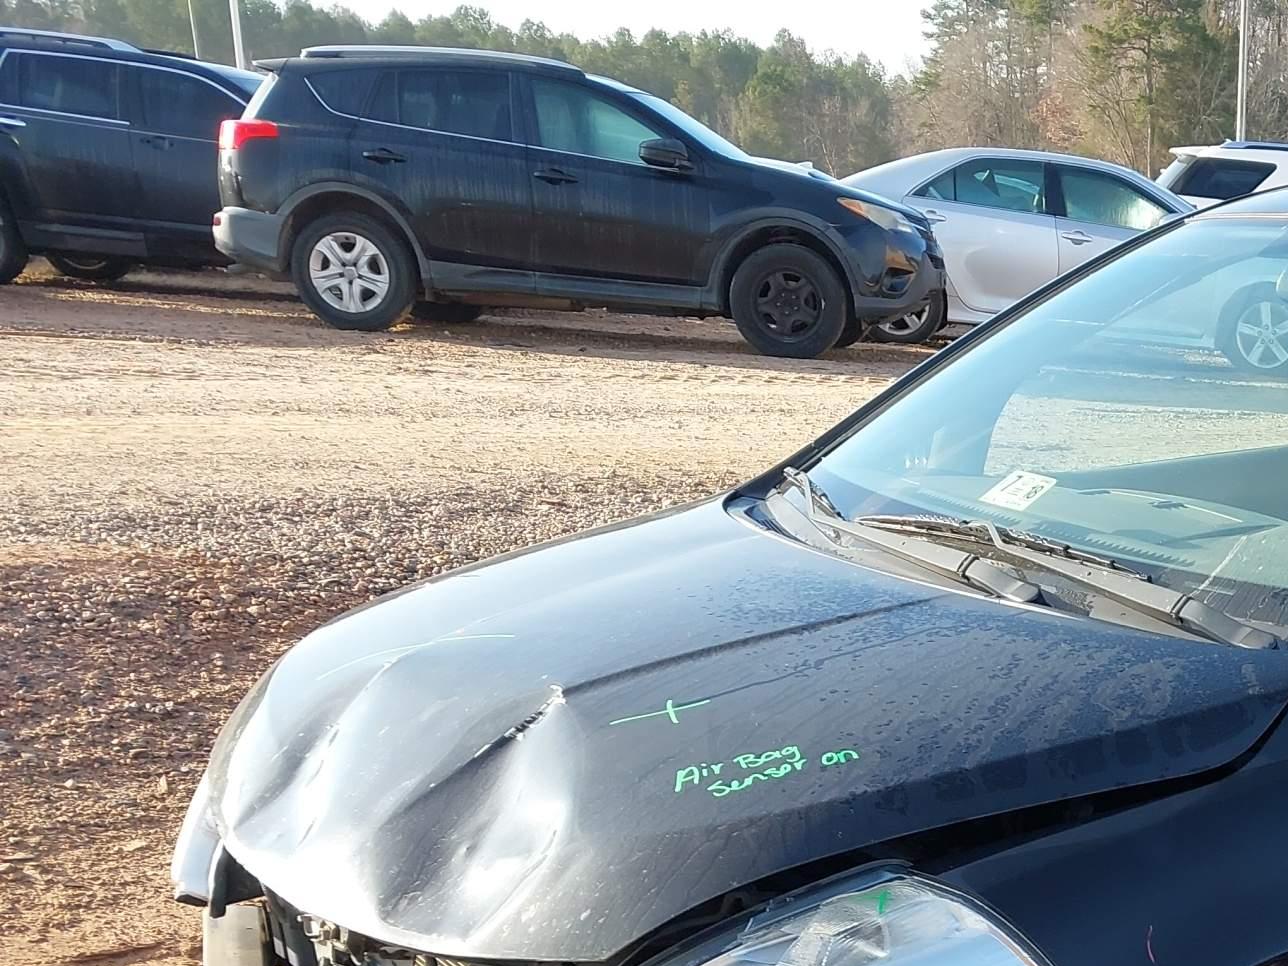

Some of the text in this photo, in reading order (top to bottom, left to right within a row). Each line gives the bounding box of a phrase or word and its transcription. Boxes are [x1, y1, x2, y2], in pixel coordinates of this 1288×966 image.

[675, 745, 801, 792] Air Bag
[820, 748, 860, 768] on
